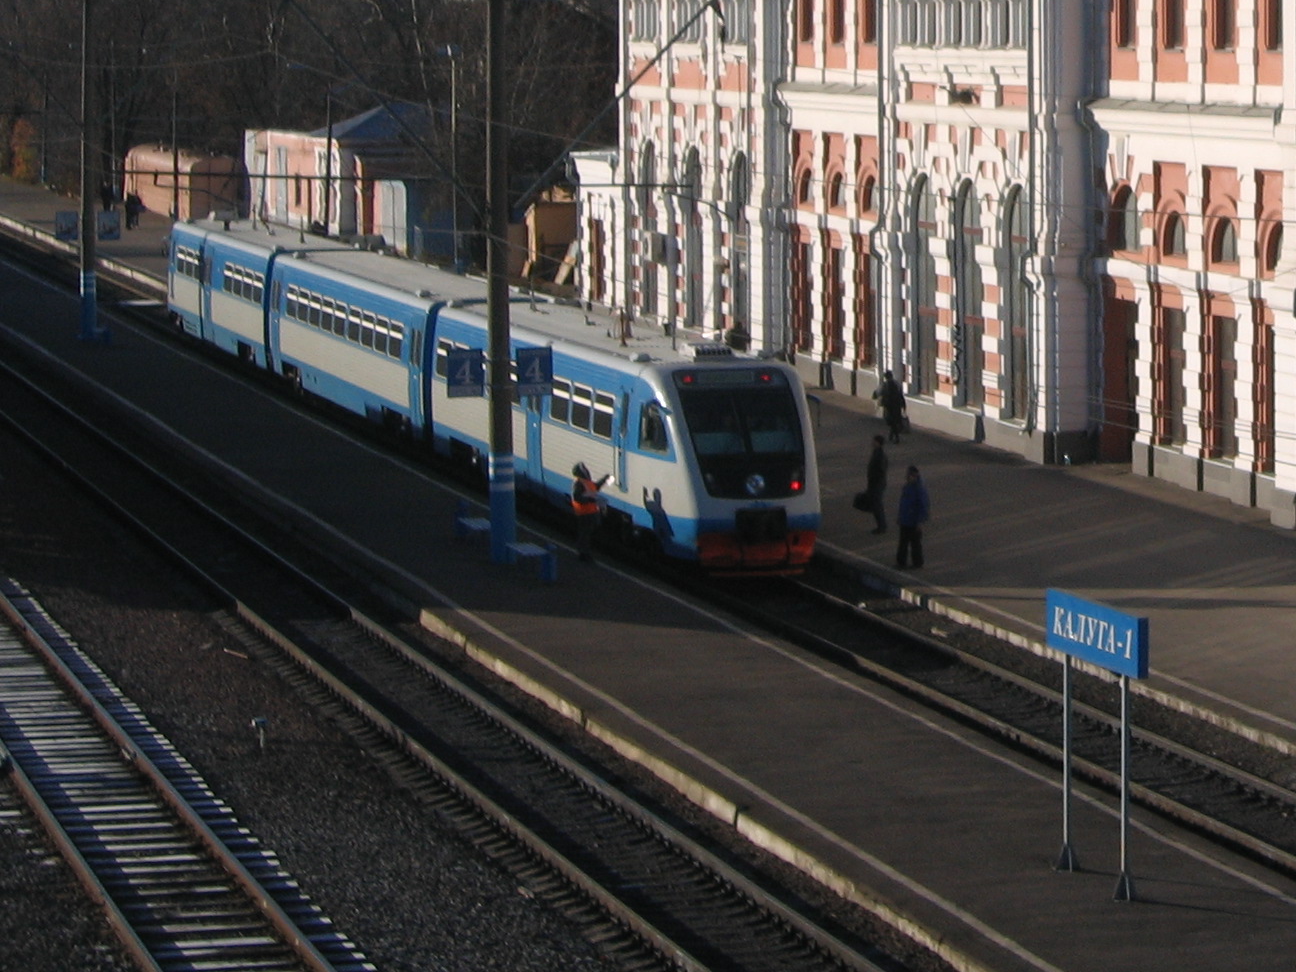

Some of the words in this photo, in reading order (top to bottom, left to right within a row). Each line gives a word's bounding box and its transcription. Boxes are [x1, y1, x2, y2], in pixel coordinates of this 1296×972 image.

[455, 358, 475, 385] 4
[524, 357, 545, 383] 4
[1053, 606, 1133, 659] КАЛУГА-1
